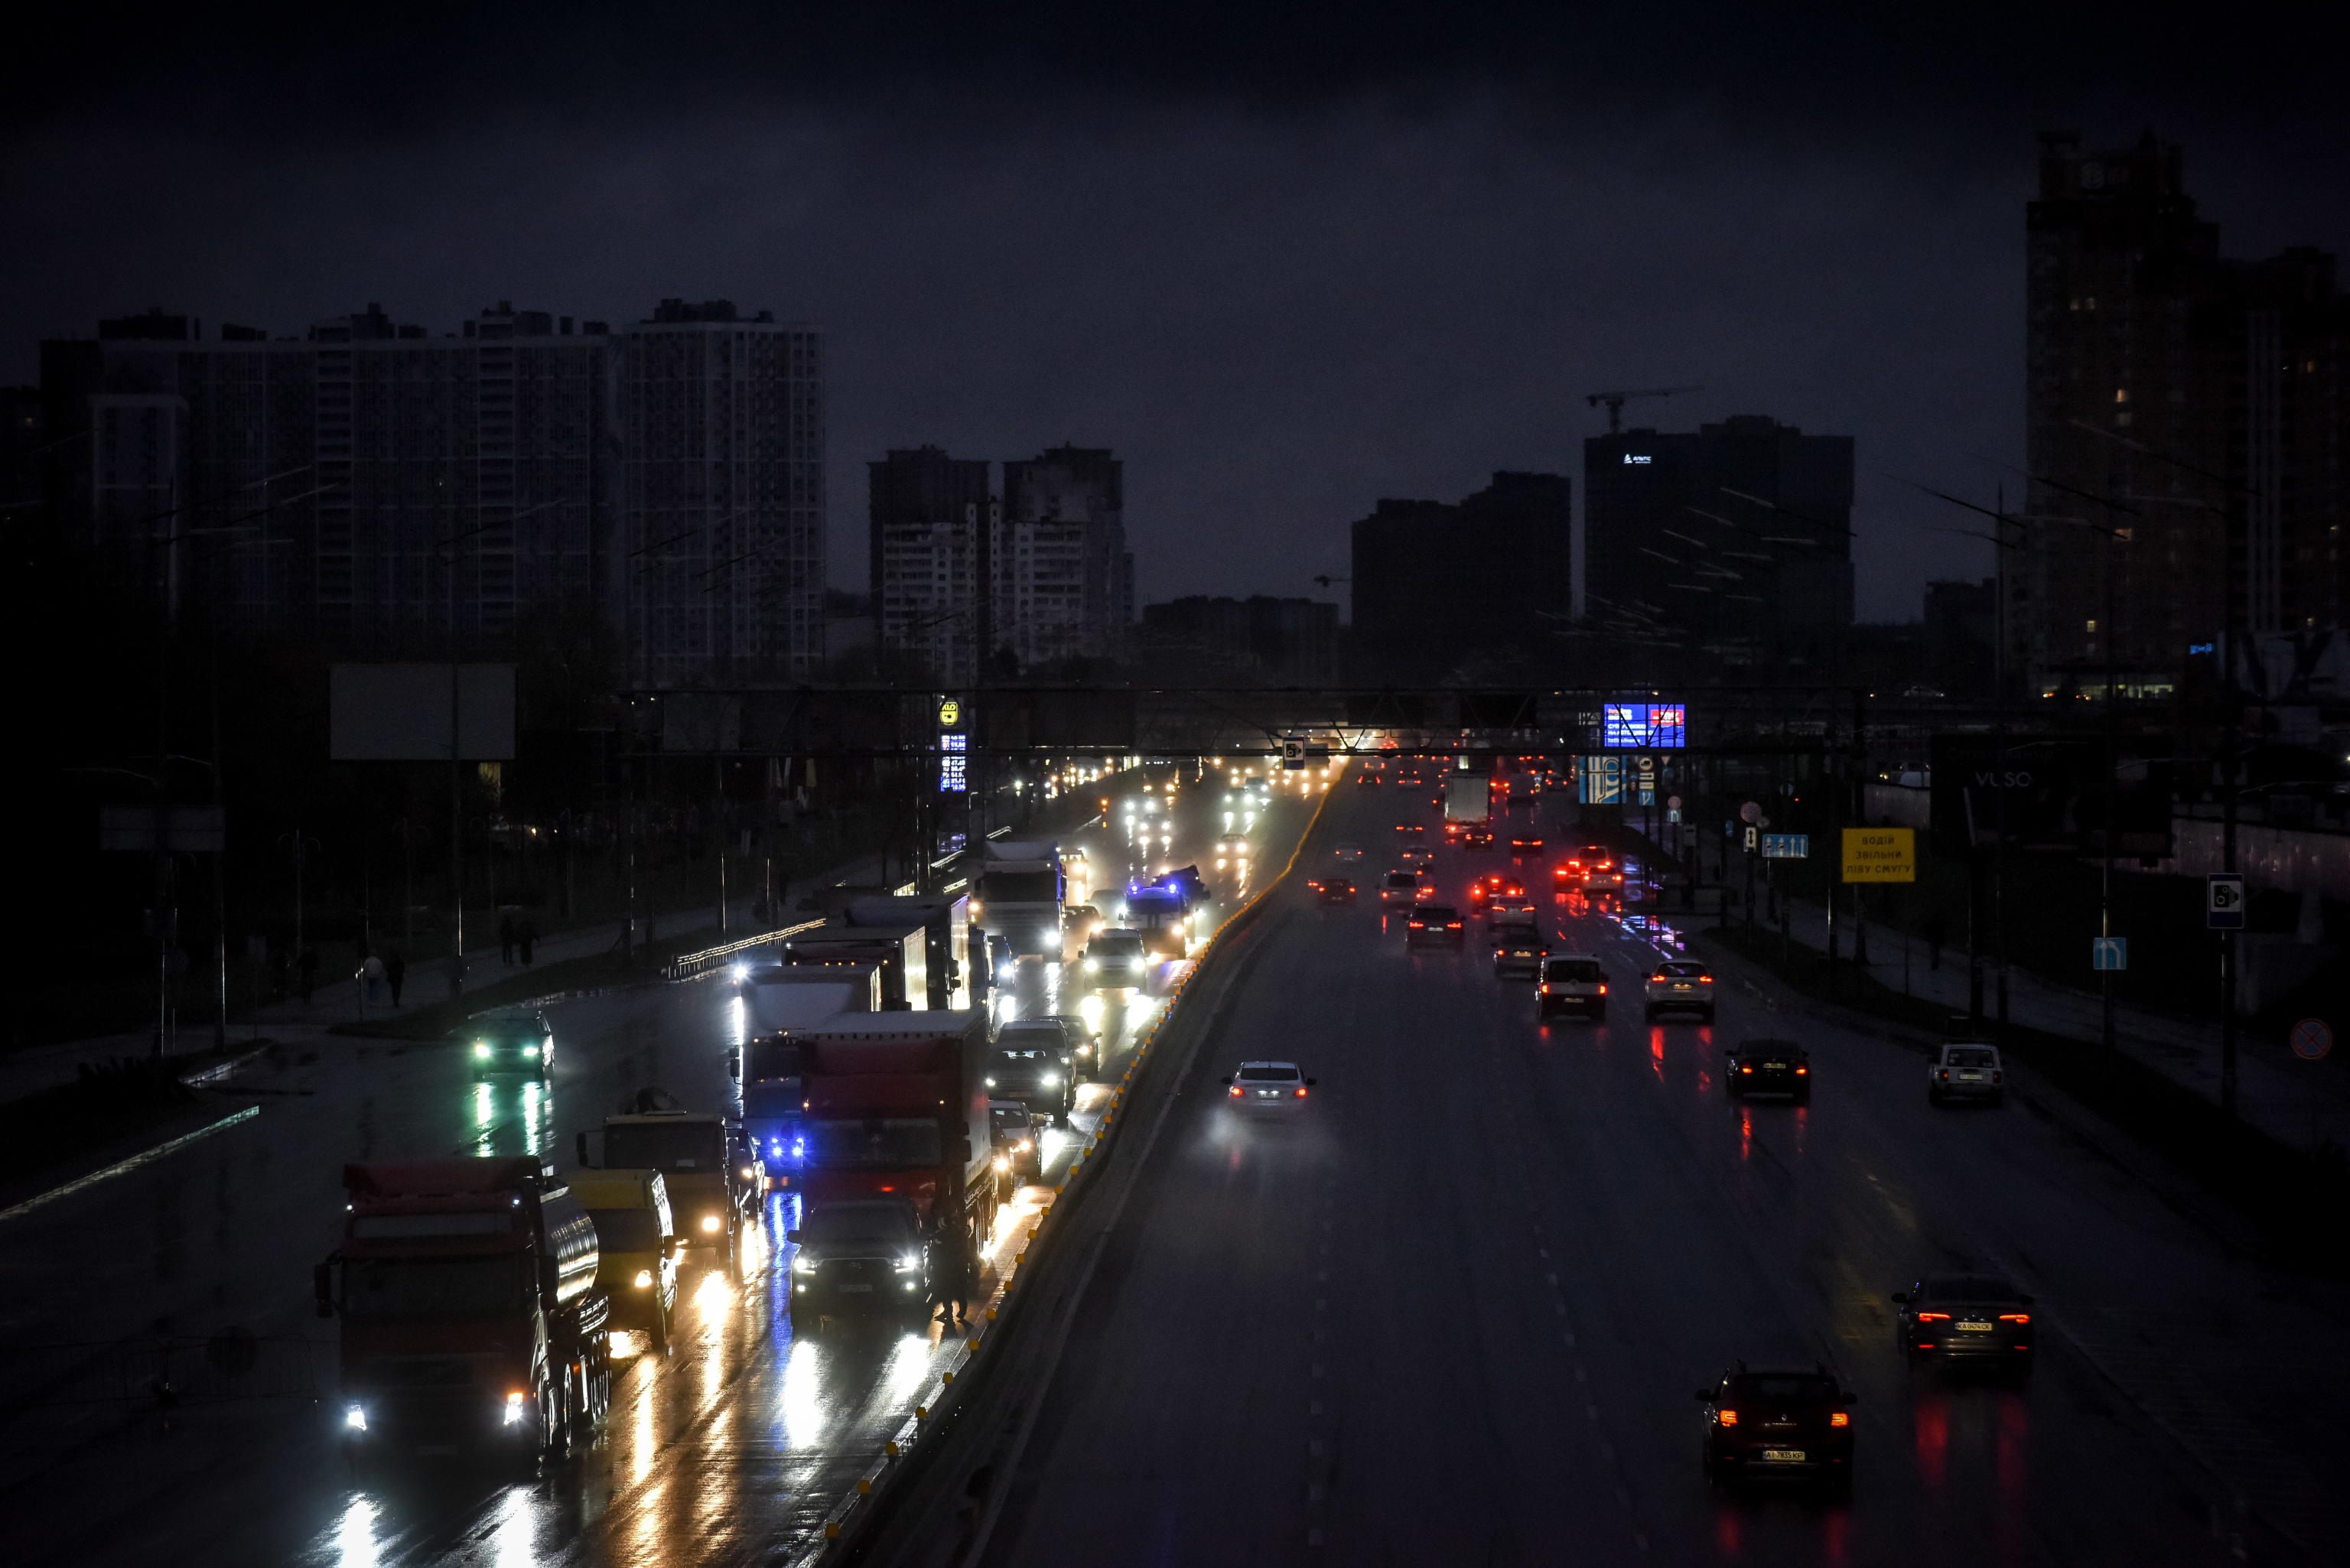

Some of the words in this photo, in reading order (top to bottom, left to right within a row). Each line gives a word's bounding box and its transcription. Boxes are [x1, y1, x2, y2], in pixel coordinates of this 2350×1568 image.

[1862, 834, 1895, 845] ВОДІЙ
[1855, 851, 1902, 860] ЗВІЛЬНИ
[1847, 864, 1871, 873] ЛІВУ
[1875, 864, 1910, 873] СМУГУ
